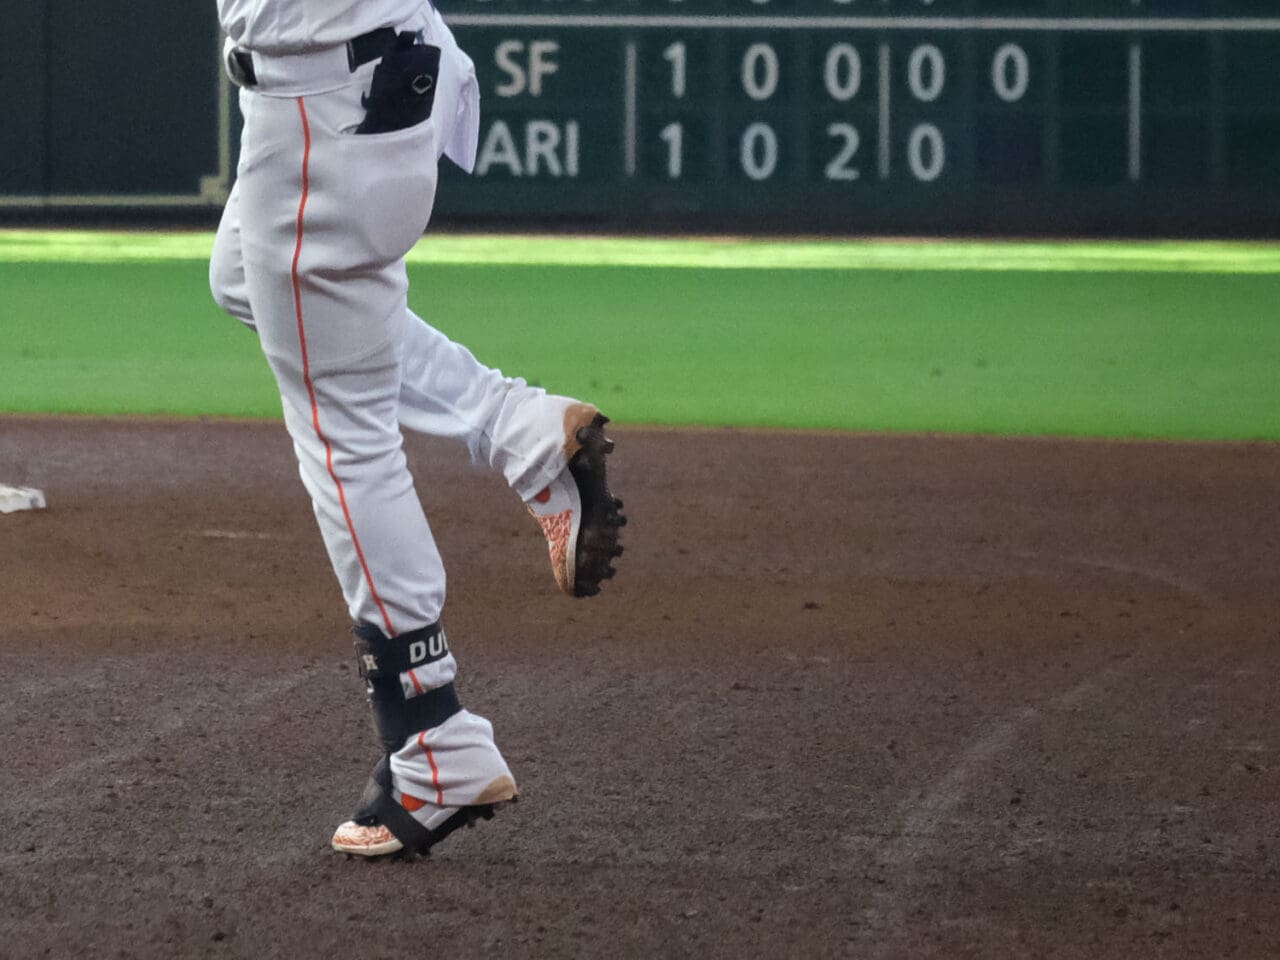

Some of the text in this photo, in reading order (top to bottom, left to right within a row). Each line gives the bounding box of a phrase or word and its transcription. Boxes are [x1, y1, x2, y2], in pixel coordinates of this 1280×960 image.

[493, 39, 1030, 102] SF 1 0 0 0 0
[475, 120, 946, 182] ARI 1 0 2 0
